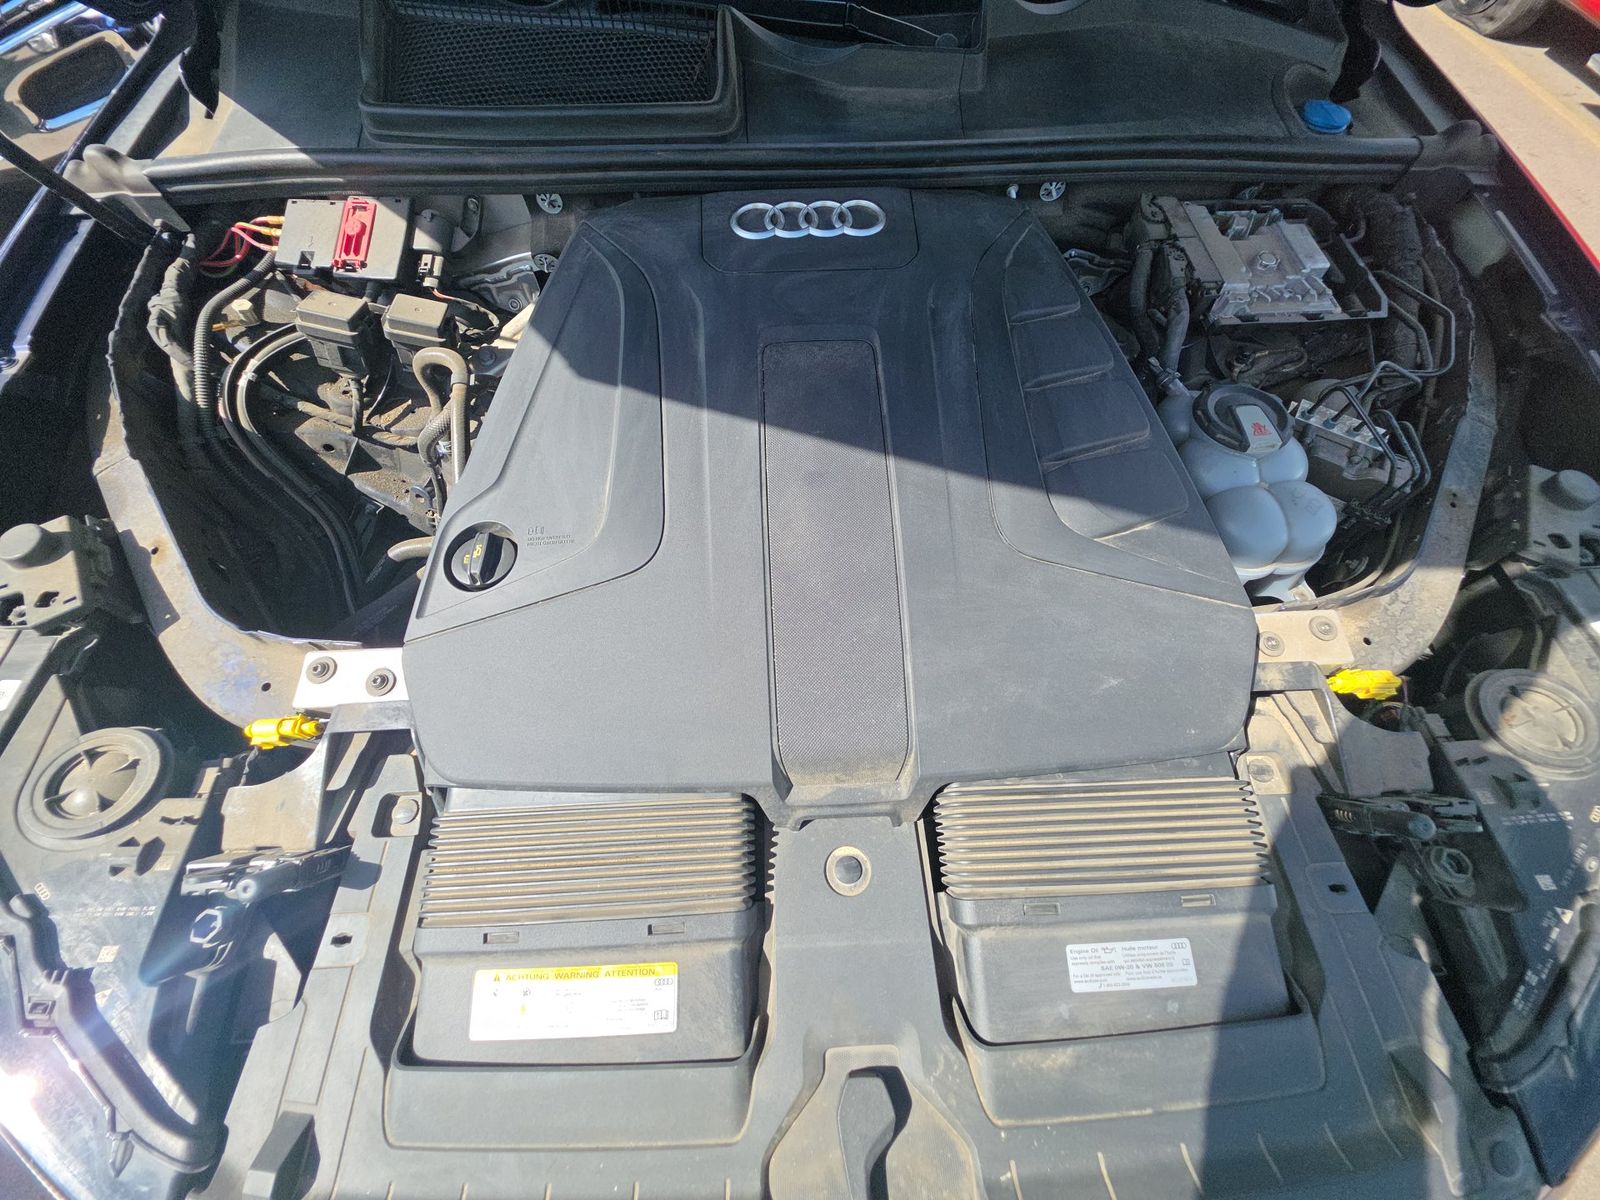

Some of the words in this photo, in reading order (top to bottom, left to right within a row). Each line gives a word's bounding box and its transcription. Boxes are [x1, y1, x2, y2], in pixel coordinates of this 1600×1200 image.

[505, 973, 549, 981] ACHTUNG
[554, 971, 600, 980] WARNING
[604, 968, 656, 977] ATTENTION
